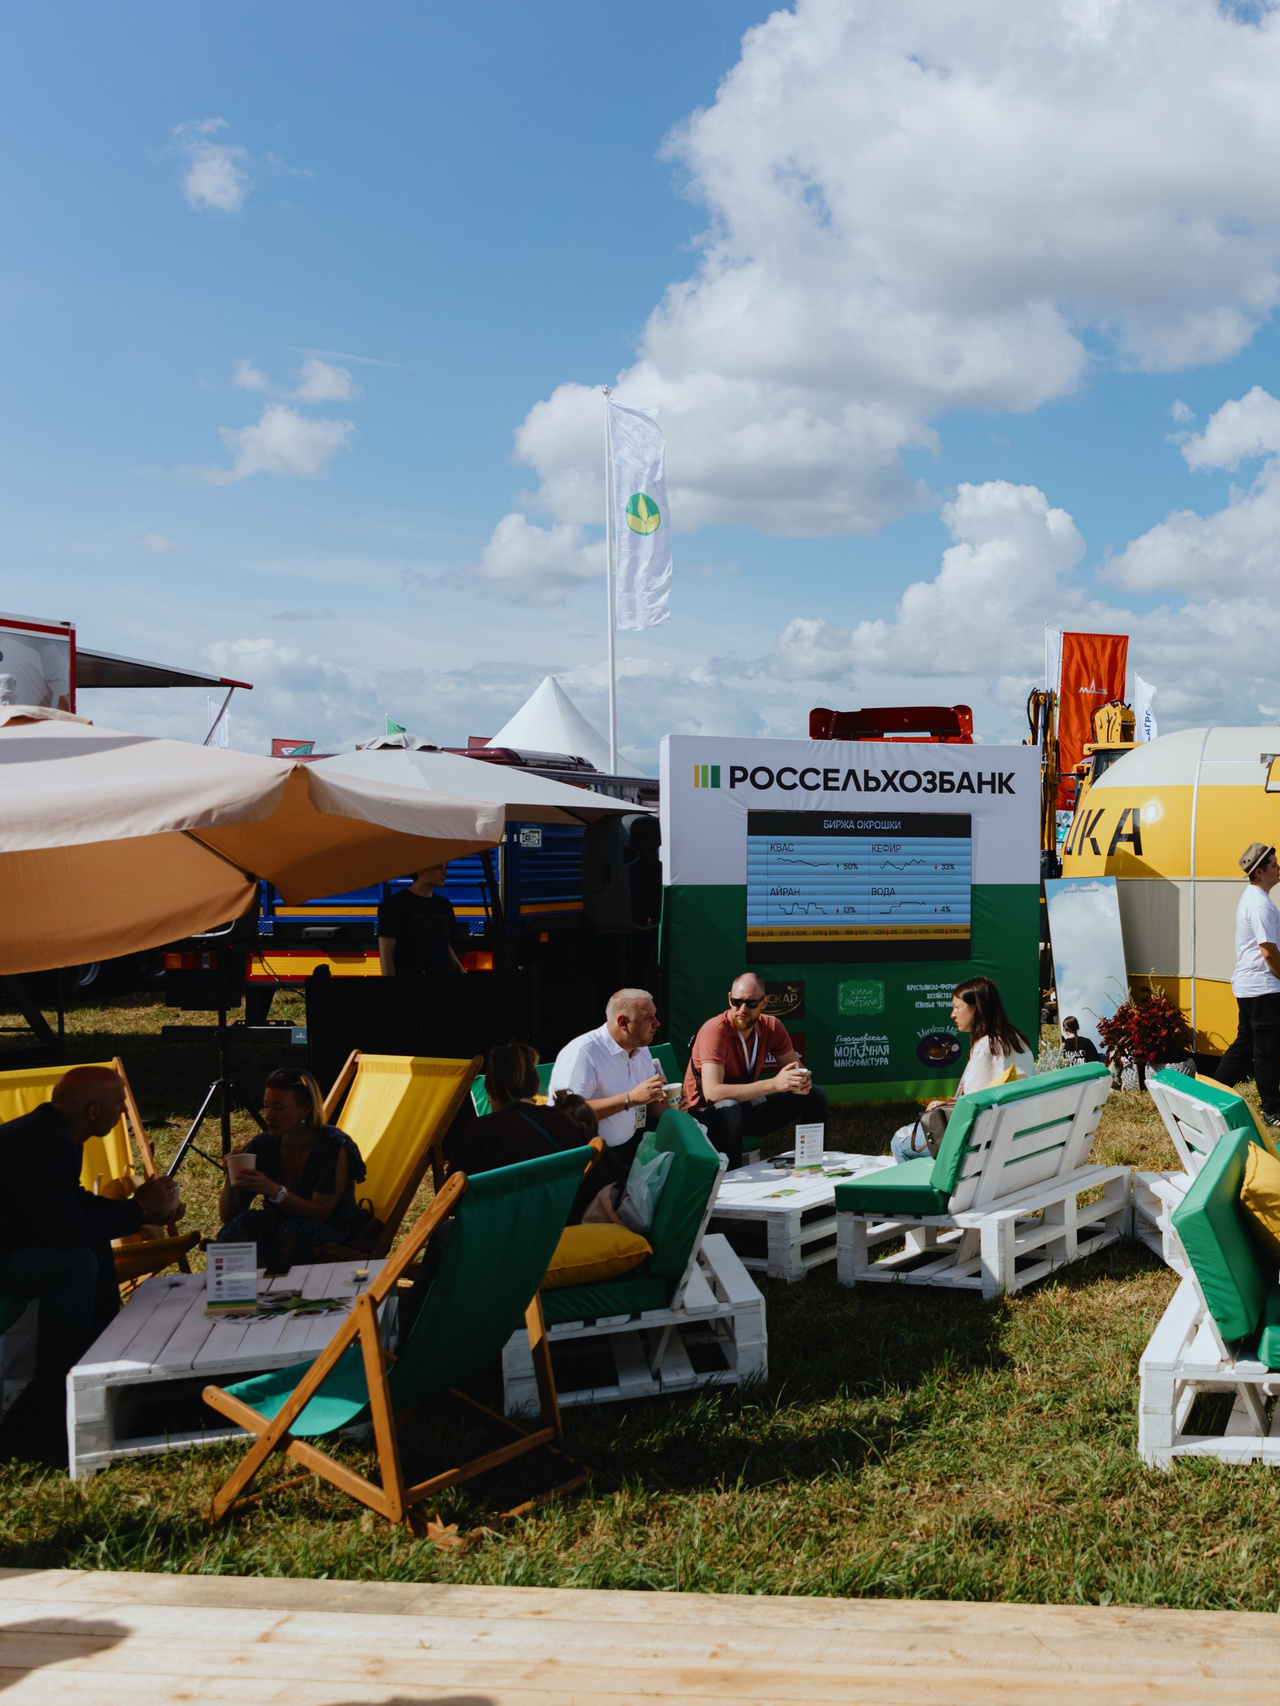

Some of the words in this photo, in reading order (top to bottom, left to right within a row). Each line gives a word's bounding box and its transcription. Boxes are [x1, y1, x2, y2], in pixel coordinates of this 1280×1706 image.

[729, 766, 1017, 795] РОССЕЛЬХОЗБАНК
[823, 819, 855, 830] БИРЖА
[856, 819, 902, 830] ОКРОШКИ
[770, 843, 795, 852] КВАС
[871, 843, 902, 853] КЕФИР
[769, 885, 801, 896] АЙРАН
[871, 887, 896, 897] ВОДА
[834, 1057, 889, 1068] МАНУФАКТУРА
